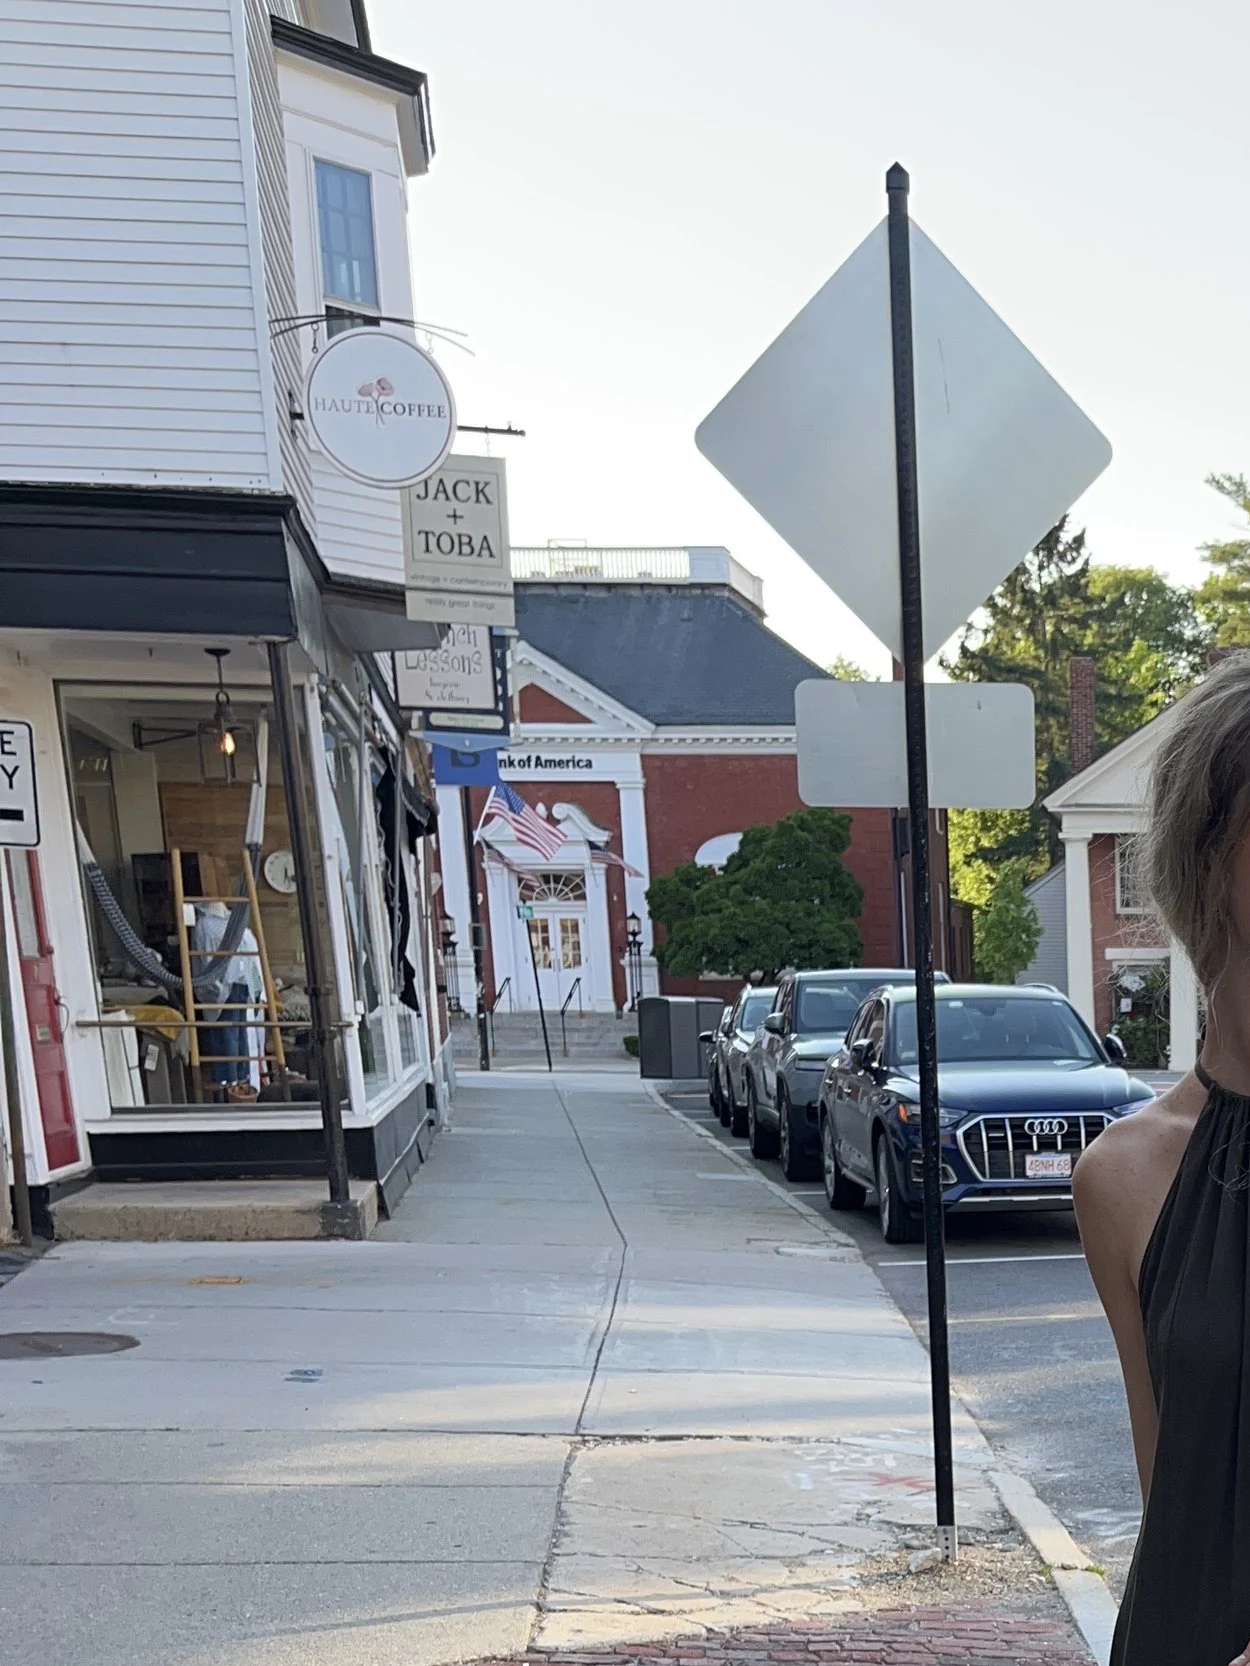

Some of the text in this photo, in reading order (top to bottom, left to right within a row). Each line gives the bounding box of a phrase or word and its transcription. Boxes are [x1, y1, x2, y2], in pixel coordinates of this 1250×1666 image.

[314, 398, 447, 419] HAUTE COFFEE
[416, 477, 493, 505] JACK
[446, 508, 464, 525] +
[417, 529, 496, 559] TOBA
[405, 649, 483, 676] Lessons
[499, 755, 593, 769] nk of America
